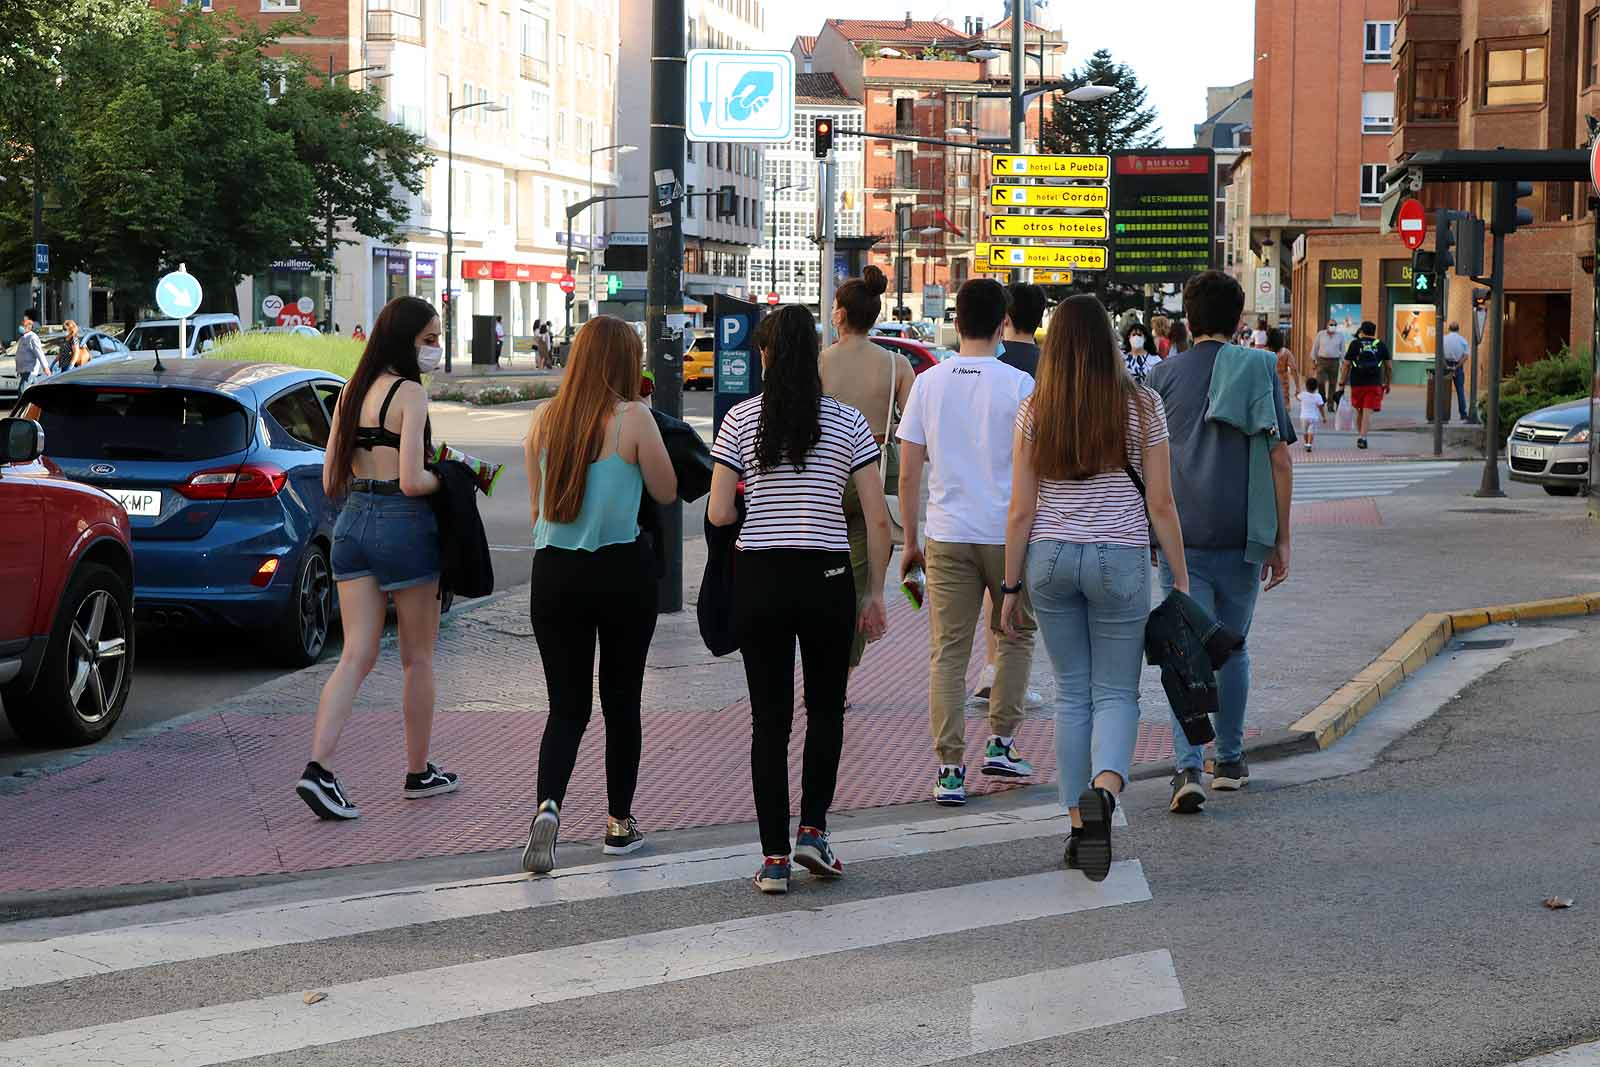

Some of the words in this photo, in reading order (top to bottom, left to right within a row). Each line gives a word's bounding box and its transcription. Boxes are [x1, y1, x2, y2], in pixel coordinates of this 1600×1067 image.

[1030, 163, 1051, 171] hotel
[1055, 162, 1066, 171] La
[1070, 162, 1104, 172] Puebla
[1036, 193, 1058, 201] hotel
[1062, 192, 1104, 201] Cordón
[1023, 222, 1054, 231] otros
[1059, 223, 1103, 232] hoteles
[1054, 253, 1101, 262] Jacobeo
[1331, 267, 1358, 280] Bankia
[723, 317, 741, 344] P
